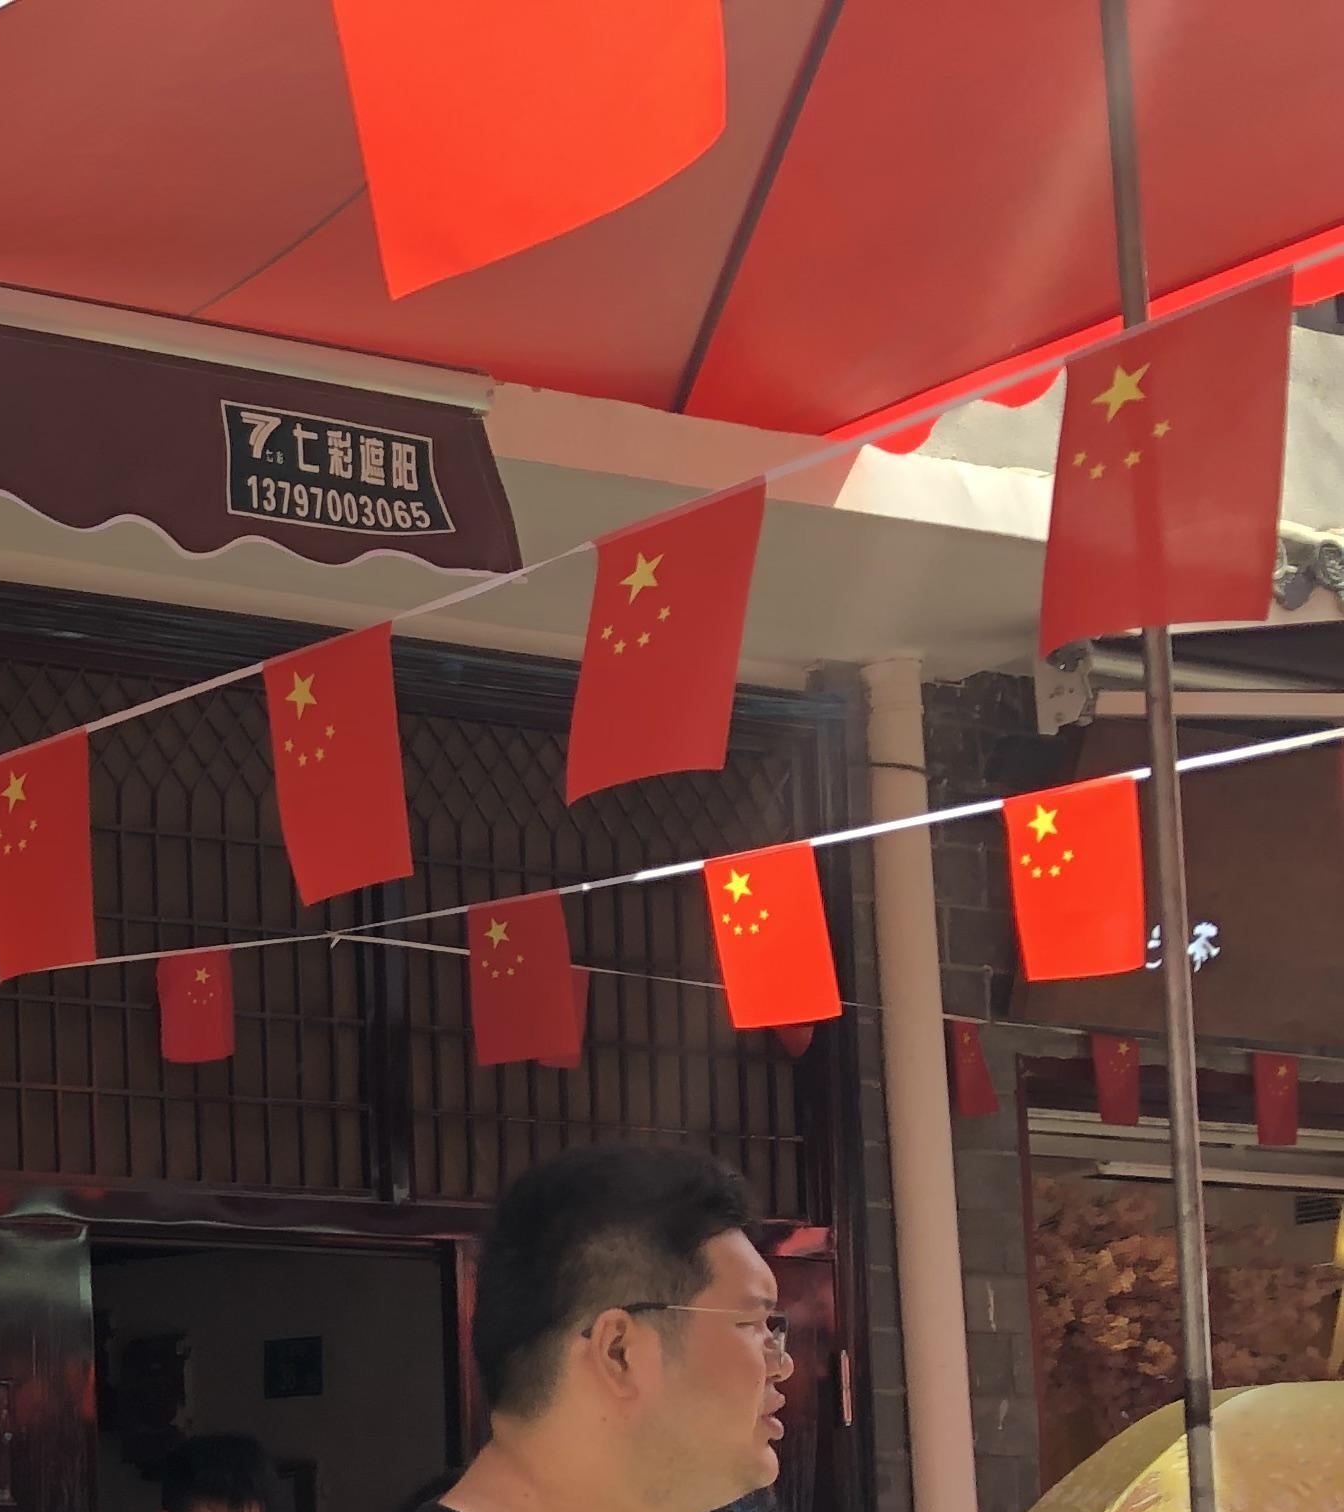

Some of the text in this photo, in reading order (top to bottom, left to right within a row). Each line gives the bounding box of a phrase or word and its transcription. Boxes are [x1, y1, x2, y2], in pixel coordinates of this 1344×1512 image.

[292, 422, 419, 491] 七彩遮阳
[246, 474, 431, 529] 13797003065
